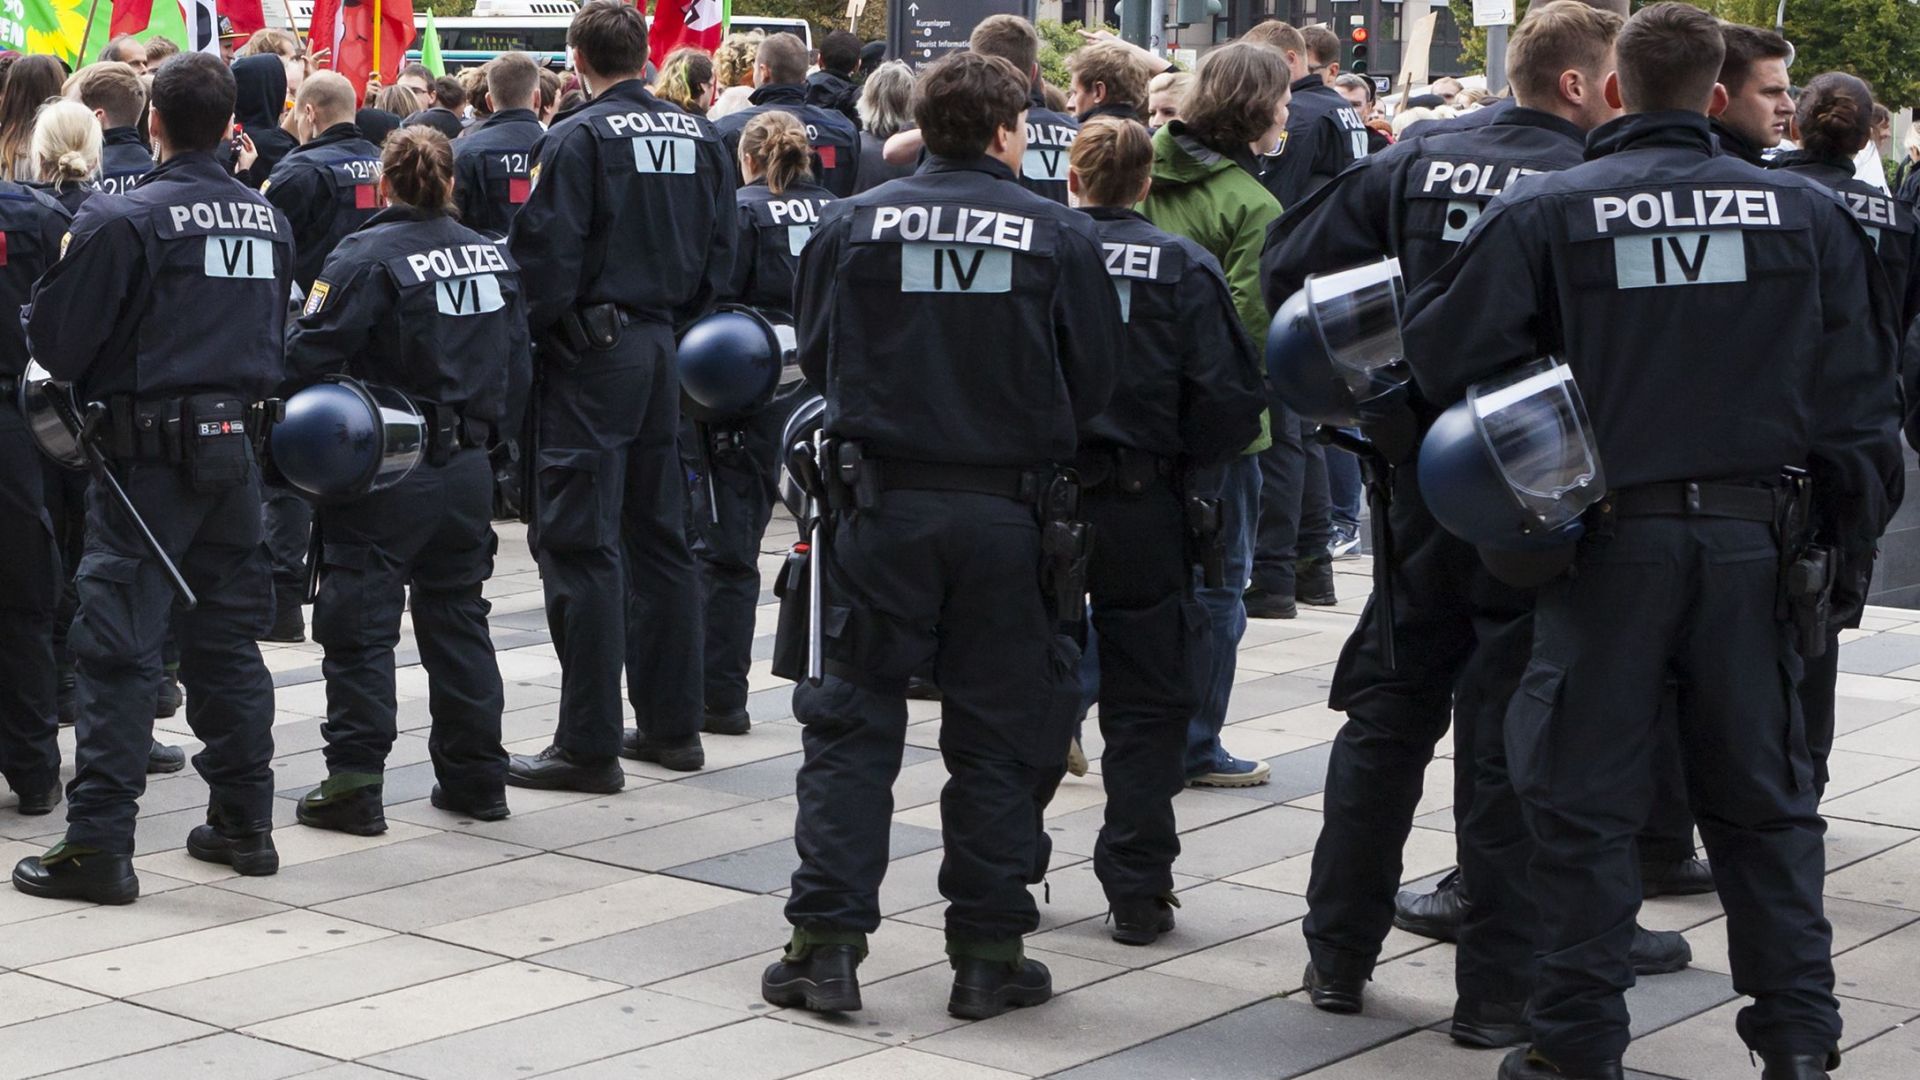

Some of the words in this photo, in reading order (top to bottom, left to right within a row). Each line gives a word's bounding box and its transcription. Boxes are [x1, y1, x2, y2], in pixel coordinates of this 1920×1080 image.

[916, 20, 951, 29] Kuranlagen
[605, 112, 704, 138] POLIZEI
[645, 139, 676, 172] VI
[1422, 160, 1546, 196] POLI
[168, 201, 278, 233] POLIZEI
[870, 205, 1035, 252] POLIZEI
[1592, 189, 1782, 233] POLIZEI
[218, 238, 255, 277] VI
[406, 244, 509, 282] POLIZEI
[933, 248, 985, 291] IV
[1651, 234, 1711, 285] IV
[443, 279, 482, 315] VI
